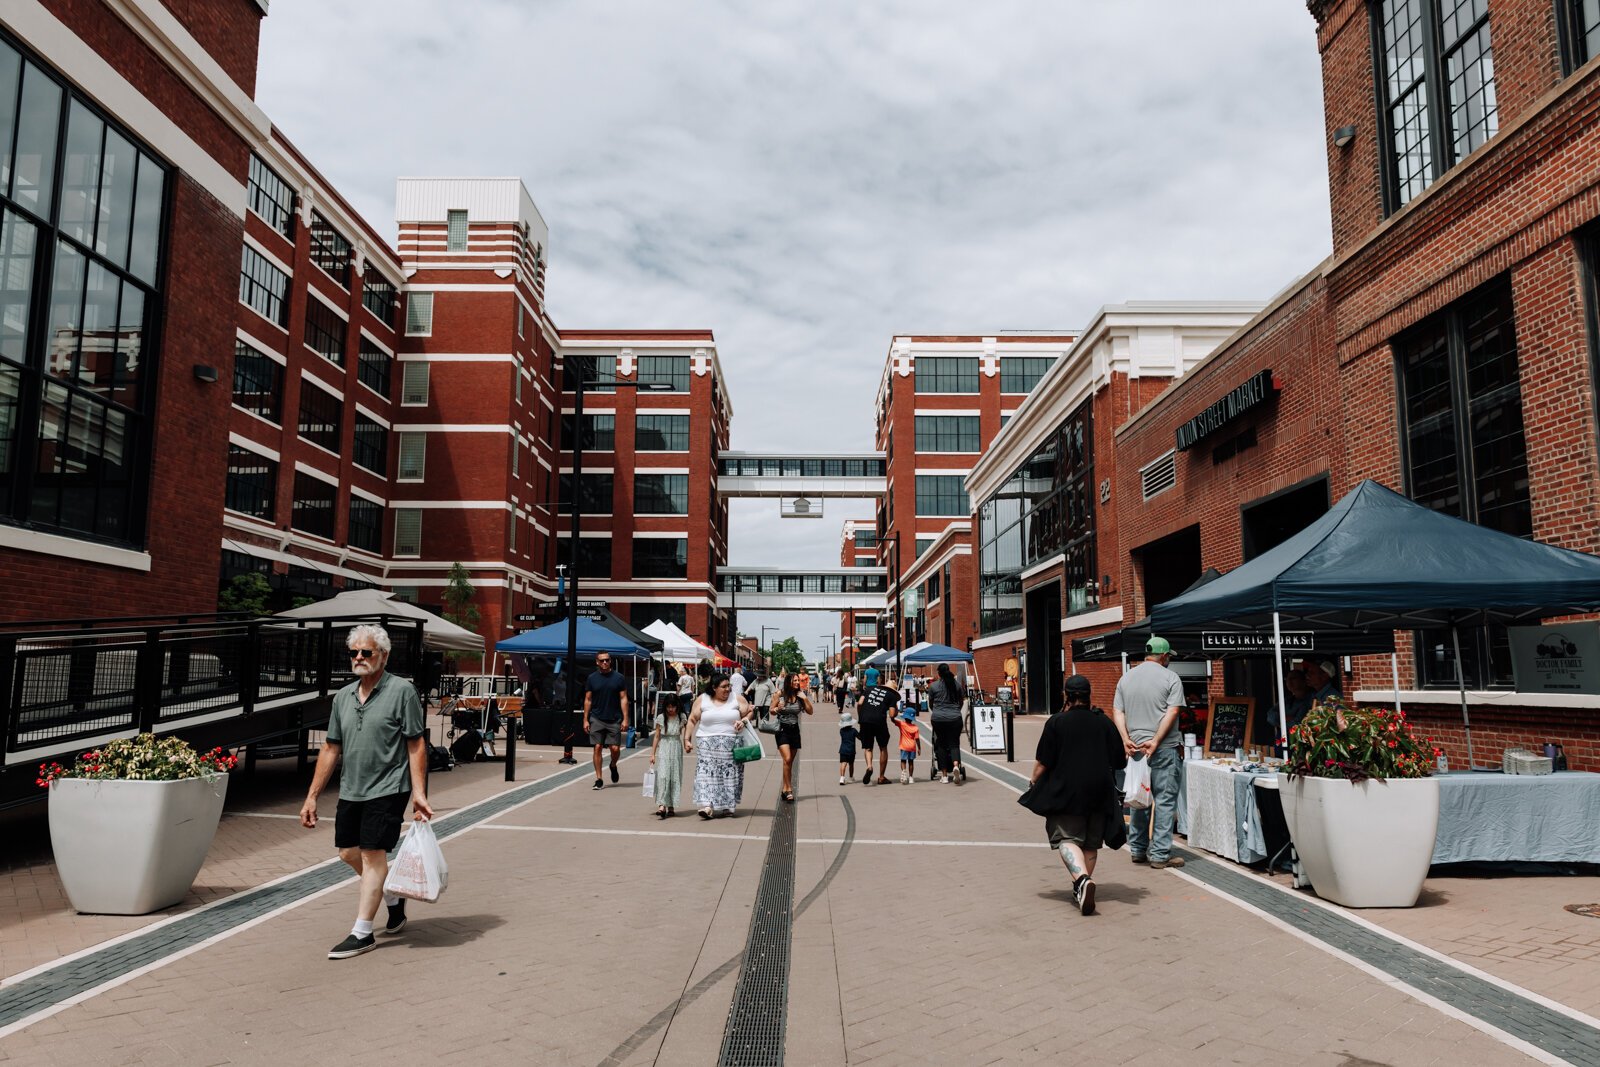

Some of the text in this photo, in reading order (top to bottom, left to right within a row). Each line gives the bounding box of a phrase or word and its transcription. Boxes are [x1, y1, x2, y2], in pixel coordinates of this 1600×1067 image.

[1177, 372, 1266, 451] UNION STREET MARKET
[1207, 635, 1263, 645] ELECTRIC
[1218, 705, 1247, 716] BUNDLES
